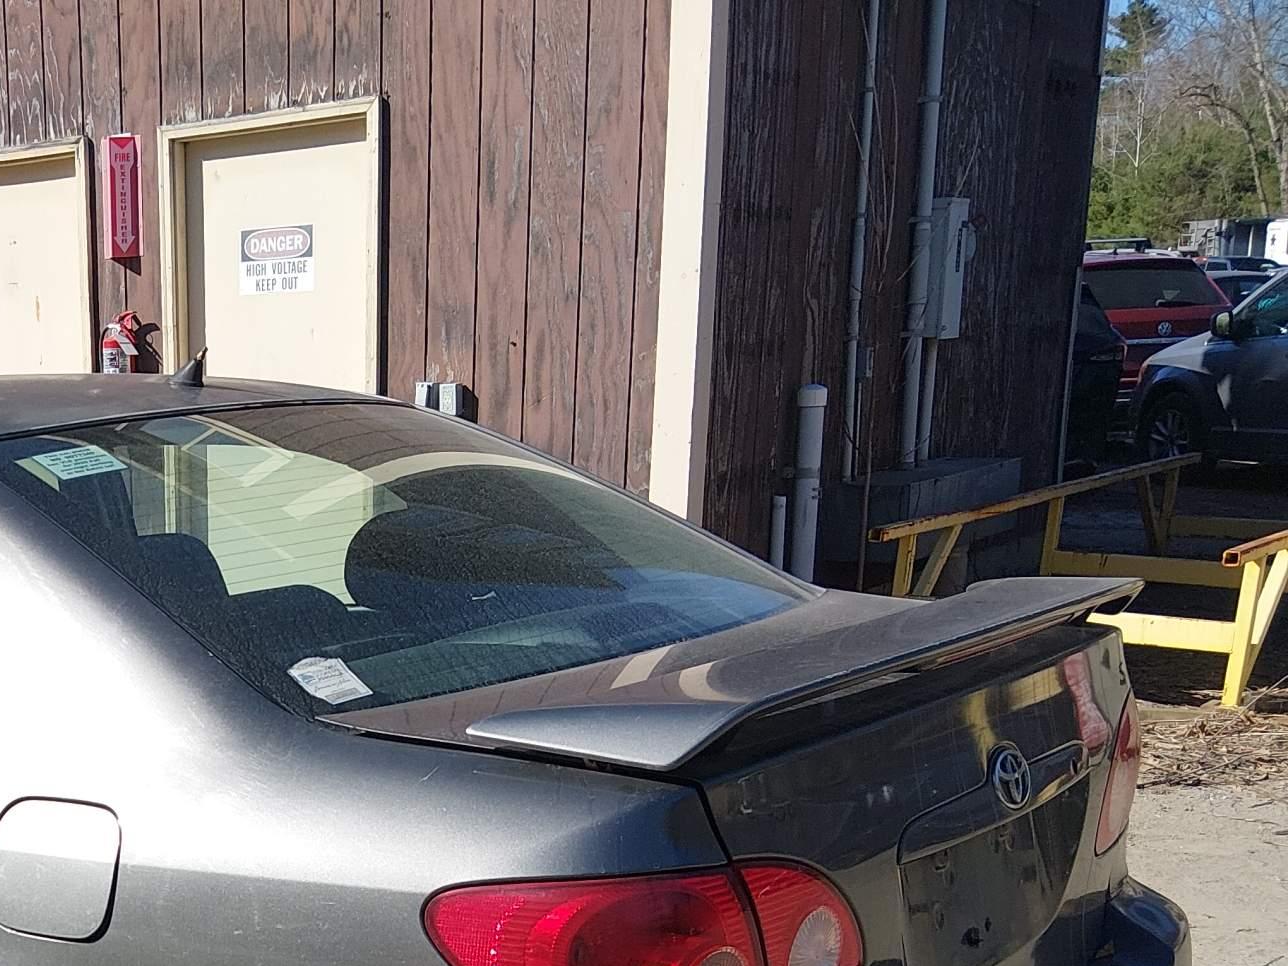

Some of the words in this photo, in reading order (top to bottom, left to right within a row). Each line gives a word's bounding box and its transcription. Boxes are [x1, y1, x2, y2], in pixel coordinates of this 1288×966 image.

[114, 153, 131, 162] FIRE
[119, 164, 128, 244] EXTINGUISHER
[250, 235, 304, 254] DANGER
[246, 263, 267, 277] HIGH
[271, 260, 308, 275] VOLTAGE
[255, 278, 277, 292] KEEP
[281, 276, 299, 290] OUT
